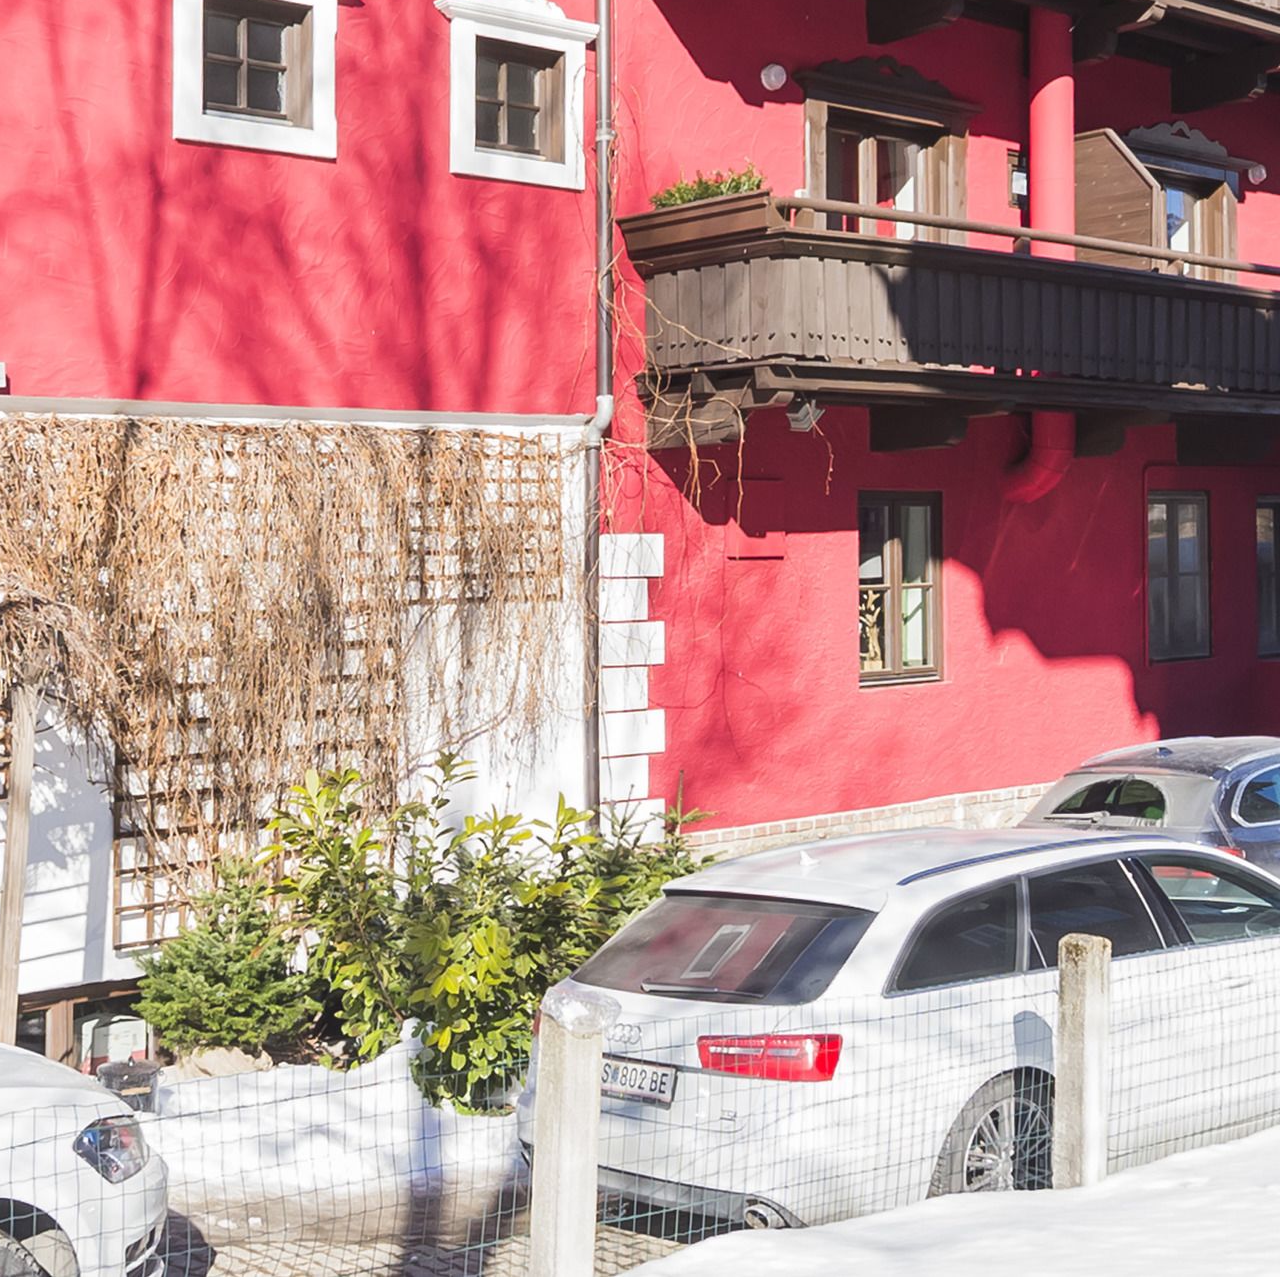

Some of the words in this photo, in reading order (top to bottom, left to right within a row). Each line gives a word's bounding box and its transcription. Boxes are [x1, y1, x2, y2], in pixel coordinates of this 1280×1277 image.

[601, 1062, 612, 1084] S
[619, 1066, 648, 1090] 802
[649, 1071, 669, 1094] BE
